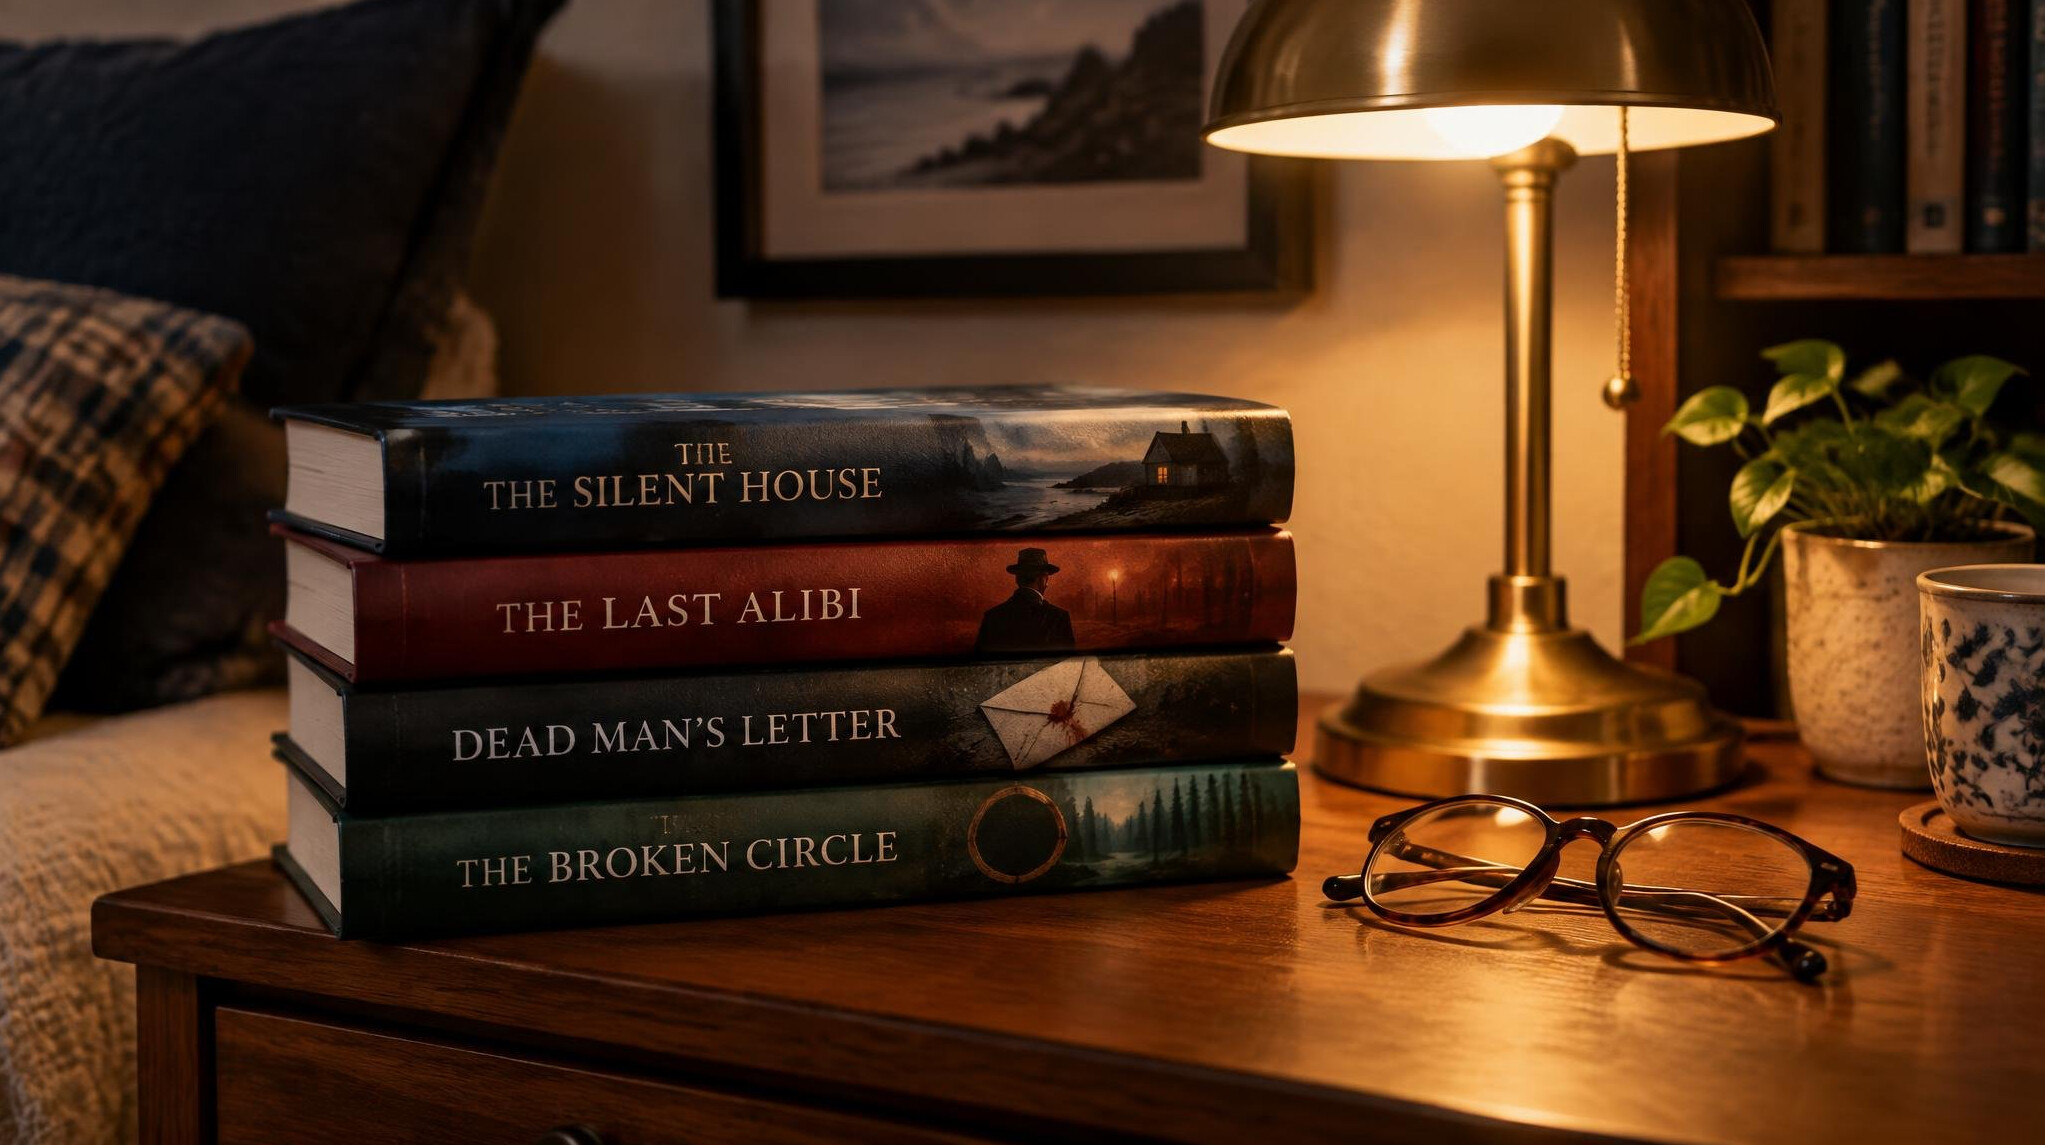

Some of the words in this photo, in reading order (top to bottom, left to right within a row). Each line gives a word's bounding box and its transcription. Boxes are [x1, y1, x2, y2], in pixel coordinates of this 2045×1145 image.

[484, 480, 557, 509] THE
[574, 472, 724, 507] SILENT
[740, 468, 882, 502] HOUSE
[497, 600, 582, 633] THE
[602, 593, 720, 629] LAST
[737, 588, 861, 623] ALIBI
[453, 725, 575, 760] DEAD
[592, 717, 724, 753] MAN’S
[742, 709, 901, 745] LETTER
[457, 856, 531, 887] THE
[549, 842, 729, 882] BROKEN
[747, 832, 897, 869] CIRCLE
